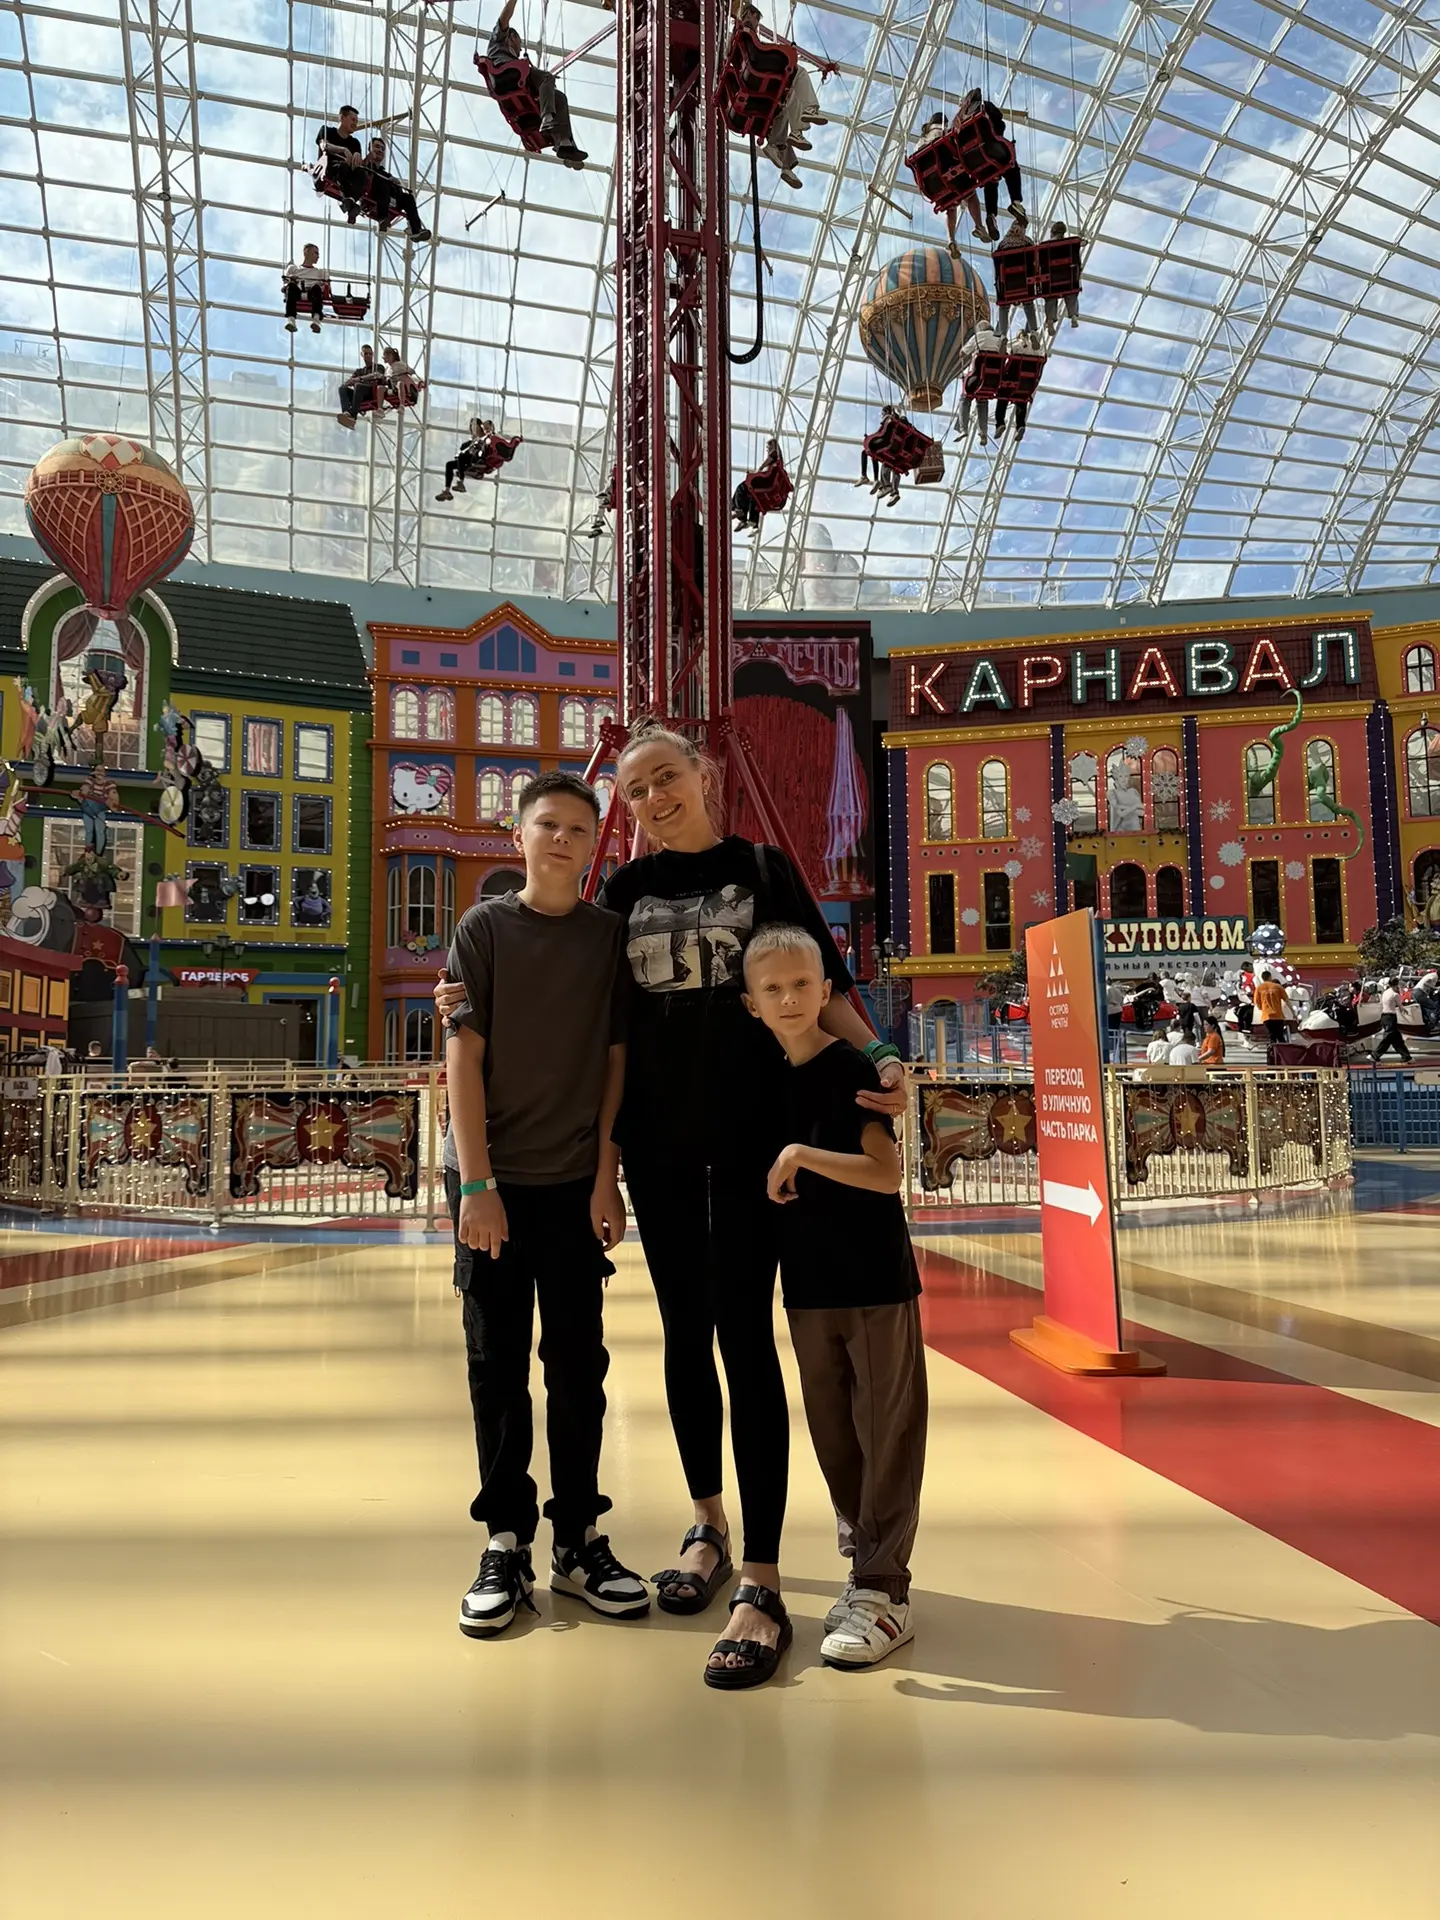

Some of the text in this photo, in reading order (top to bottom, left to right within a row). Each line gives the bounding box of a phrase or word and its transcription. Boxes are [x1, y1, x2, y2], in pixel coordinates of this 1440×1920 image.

[777, 643, 855, 687] МЕЧТЫ
[905, 628, 1360, 715] КАРНАВАЛ
[1103, 919, 1245, 953] КУПОЛОМ
[1105, 960, 1227, 971] ЛЬНЫЙ РЕСТОРАН
[1049, 1003, 1070, 1017] ОСТРОВ
[1045, 1067, 1085, 1089] ПЕРЕХОД
[1042, 1094, 1092, 1114] В УЛИЧНУЮ
[1040, 1119, 1098, 1143] ЧАСТЬ ПАРКА
